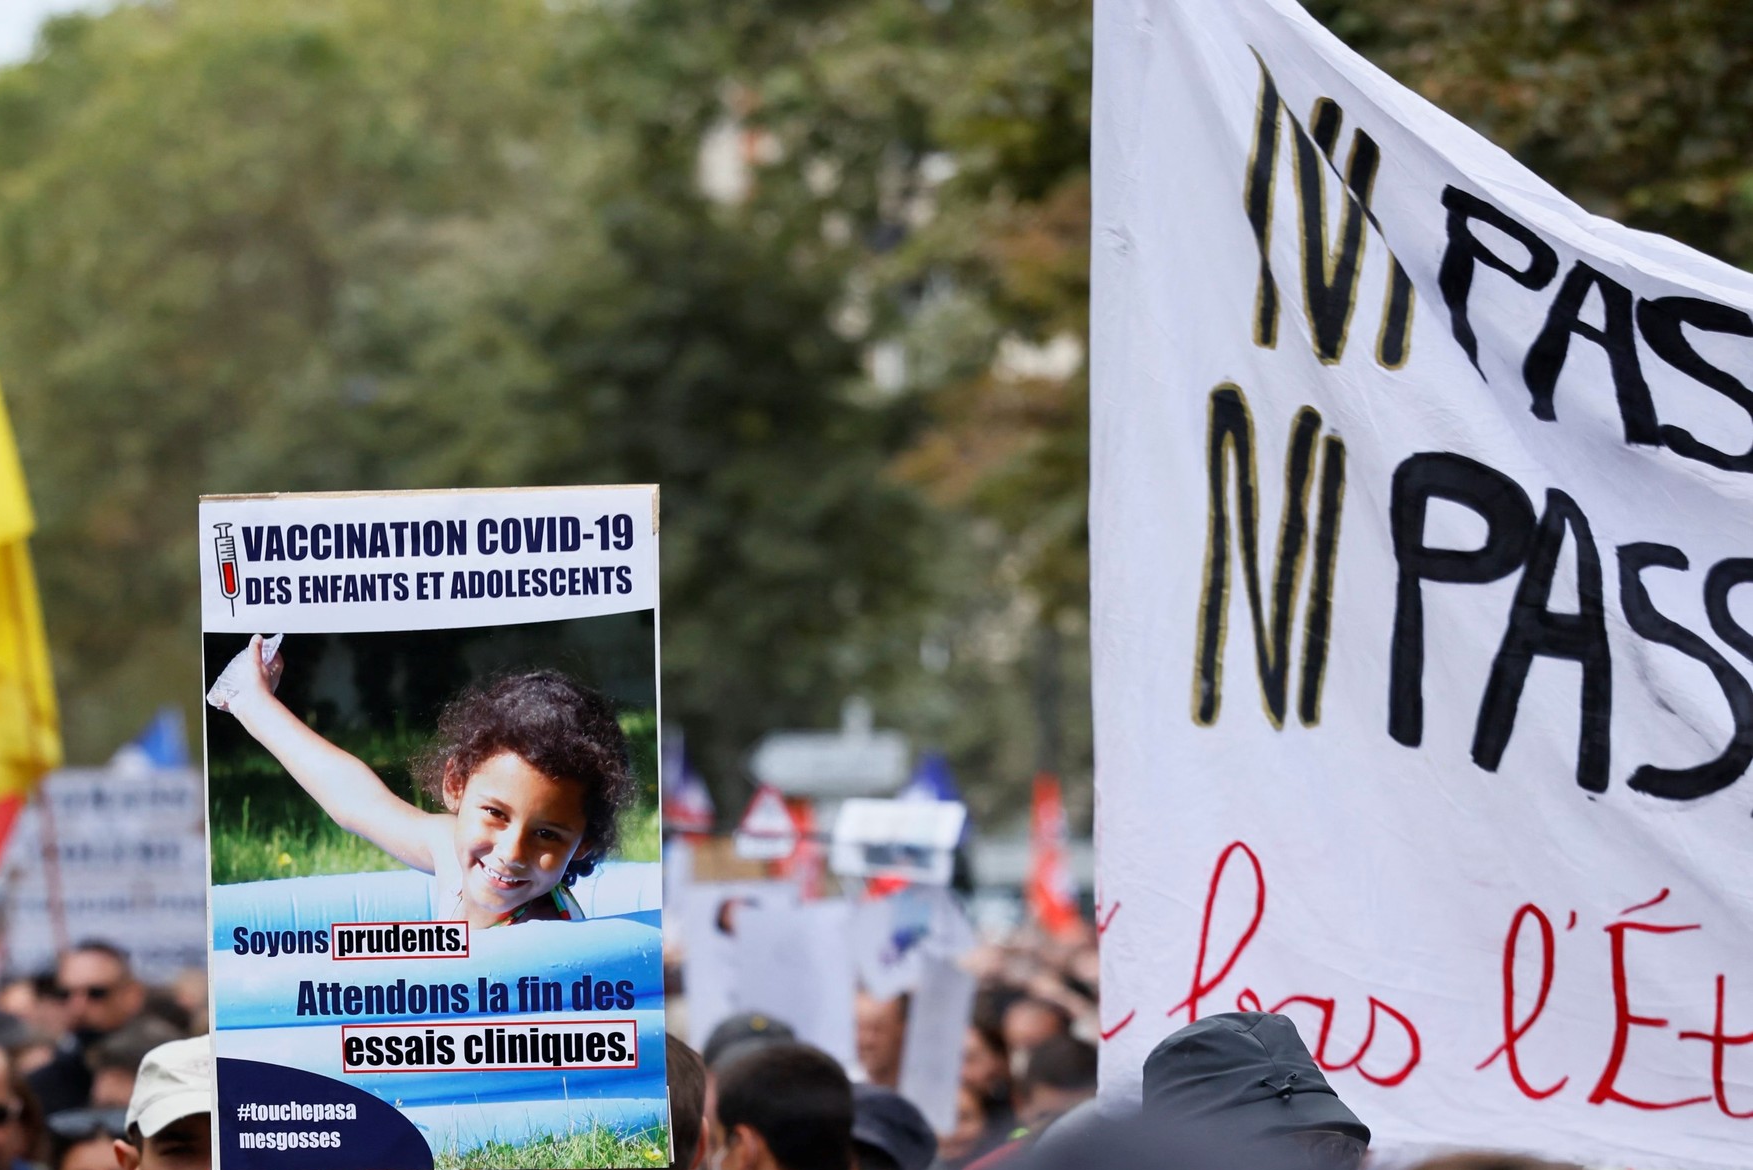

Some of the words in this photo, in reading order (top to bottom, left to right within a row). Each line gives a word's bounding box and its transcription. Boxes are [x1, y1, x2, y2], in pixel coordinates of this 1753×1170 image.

[1244, 42, 1416, 371] NI
[242, 520, 466, 562] VACCINATION
[476, 513, 635, 555] COVID-19
[1191, 381, 1347, 731] NI
[245, 577, 291, 605] DES
[300, 572, 410, 602] ENFANTS
[417, 571, 445, 599] ET
[451, 565, 632, 599] ADOLESCENTS
[233, 926, 329, 957] Soyons
[338, 924, 467, 957] prudents.
[297, 979, 470, 1016] Attendons
[478, 978, 507, 1012] la
[516, 976, 564, 1012] fin
[571, 974, 634, 1010] des
[345, 1031, 456, 1067] essais
[464, 1027, 635, 1067] cliniques.
[237, 1101, 356, 1123] #touchepasa
[239, 1129, 341, 1150] mesgosses
